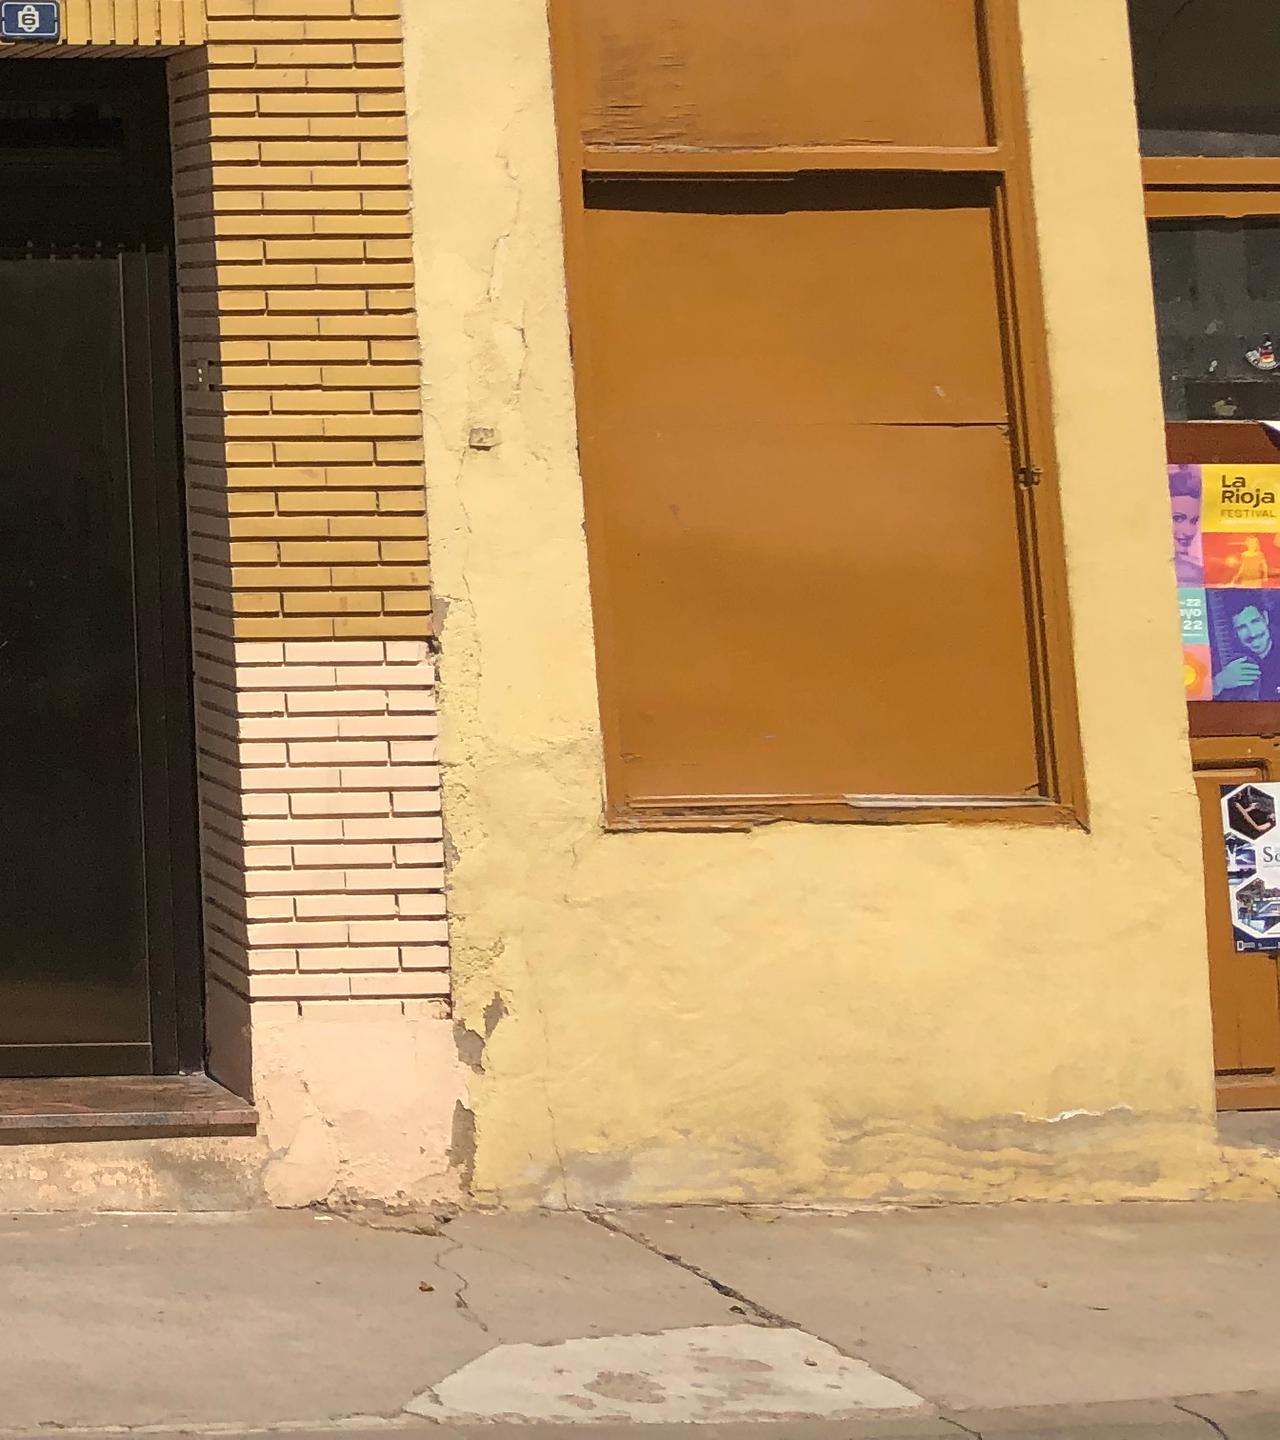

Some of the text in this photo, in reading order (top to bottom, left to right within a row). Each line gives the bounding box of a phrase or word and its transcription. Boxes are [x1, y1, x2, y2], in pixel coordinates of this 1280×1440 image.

[21, 13, 36, 26] 6
[1221, 474, 1246, 488] La
[1221, 488, 1276, 509] Rioja
[1220, 509, 1278, 519] FESTIVAL
